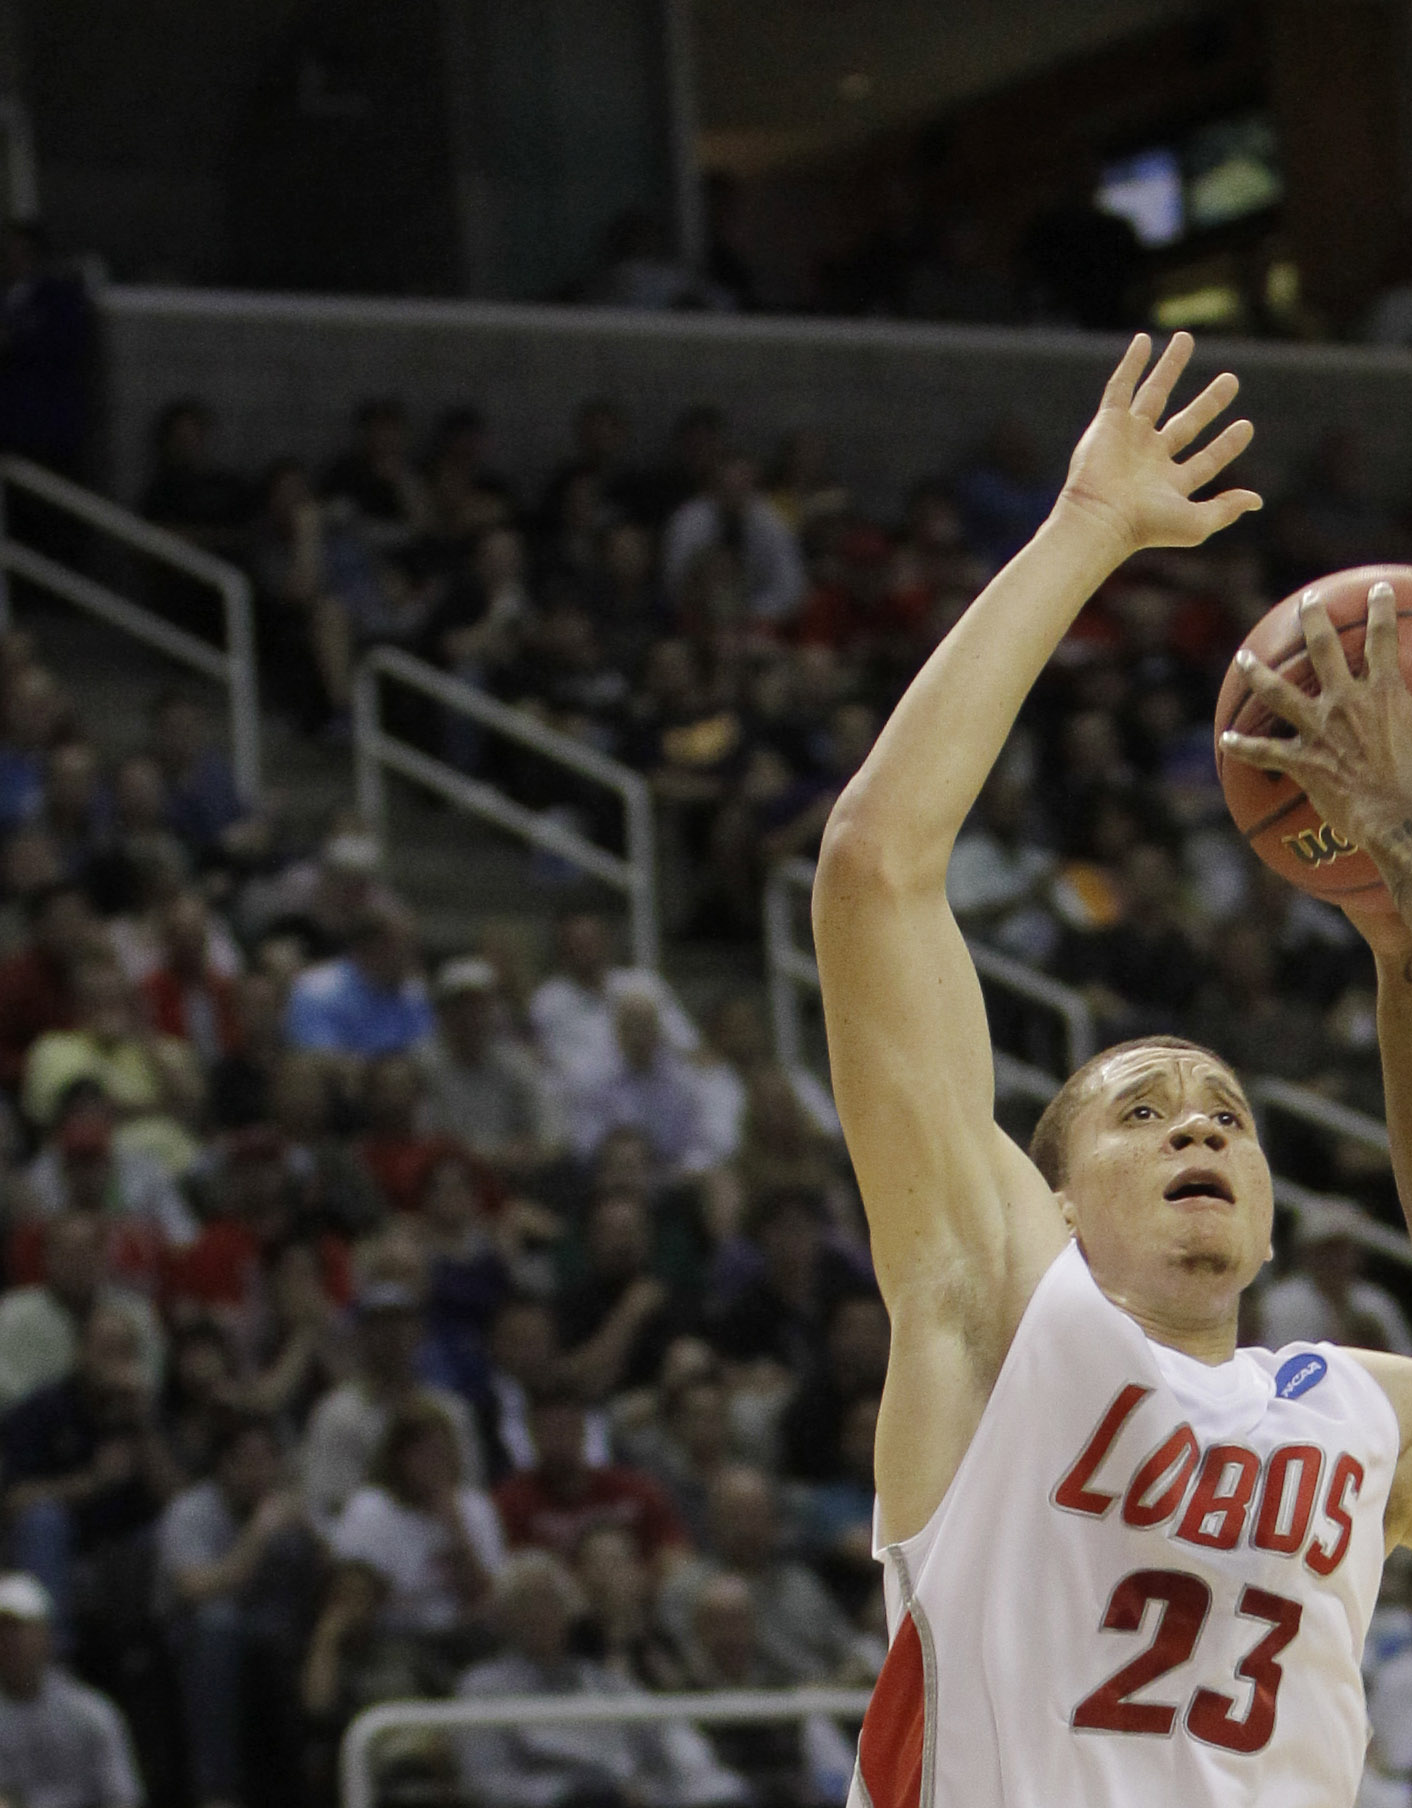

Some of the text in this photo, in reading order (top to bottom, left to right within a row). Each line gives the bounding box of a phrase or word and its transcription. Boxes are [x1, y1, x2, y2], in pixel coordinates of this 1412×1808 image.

[1281, 1361, 1322, 1398] NCAA
[1049, 1382, 1365, 1578] LOBOS
[1070, 1568, 1304, 1756] 23
